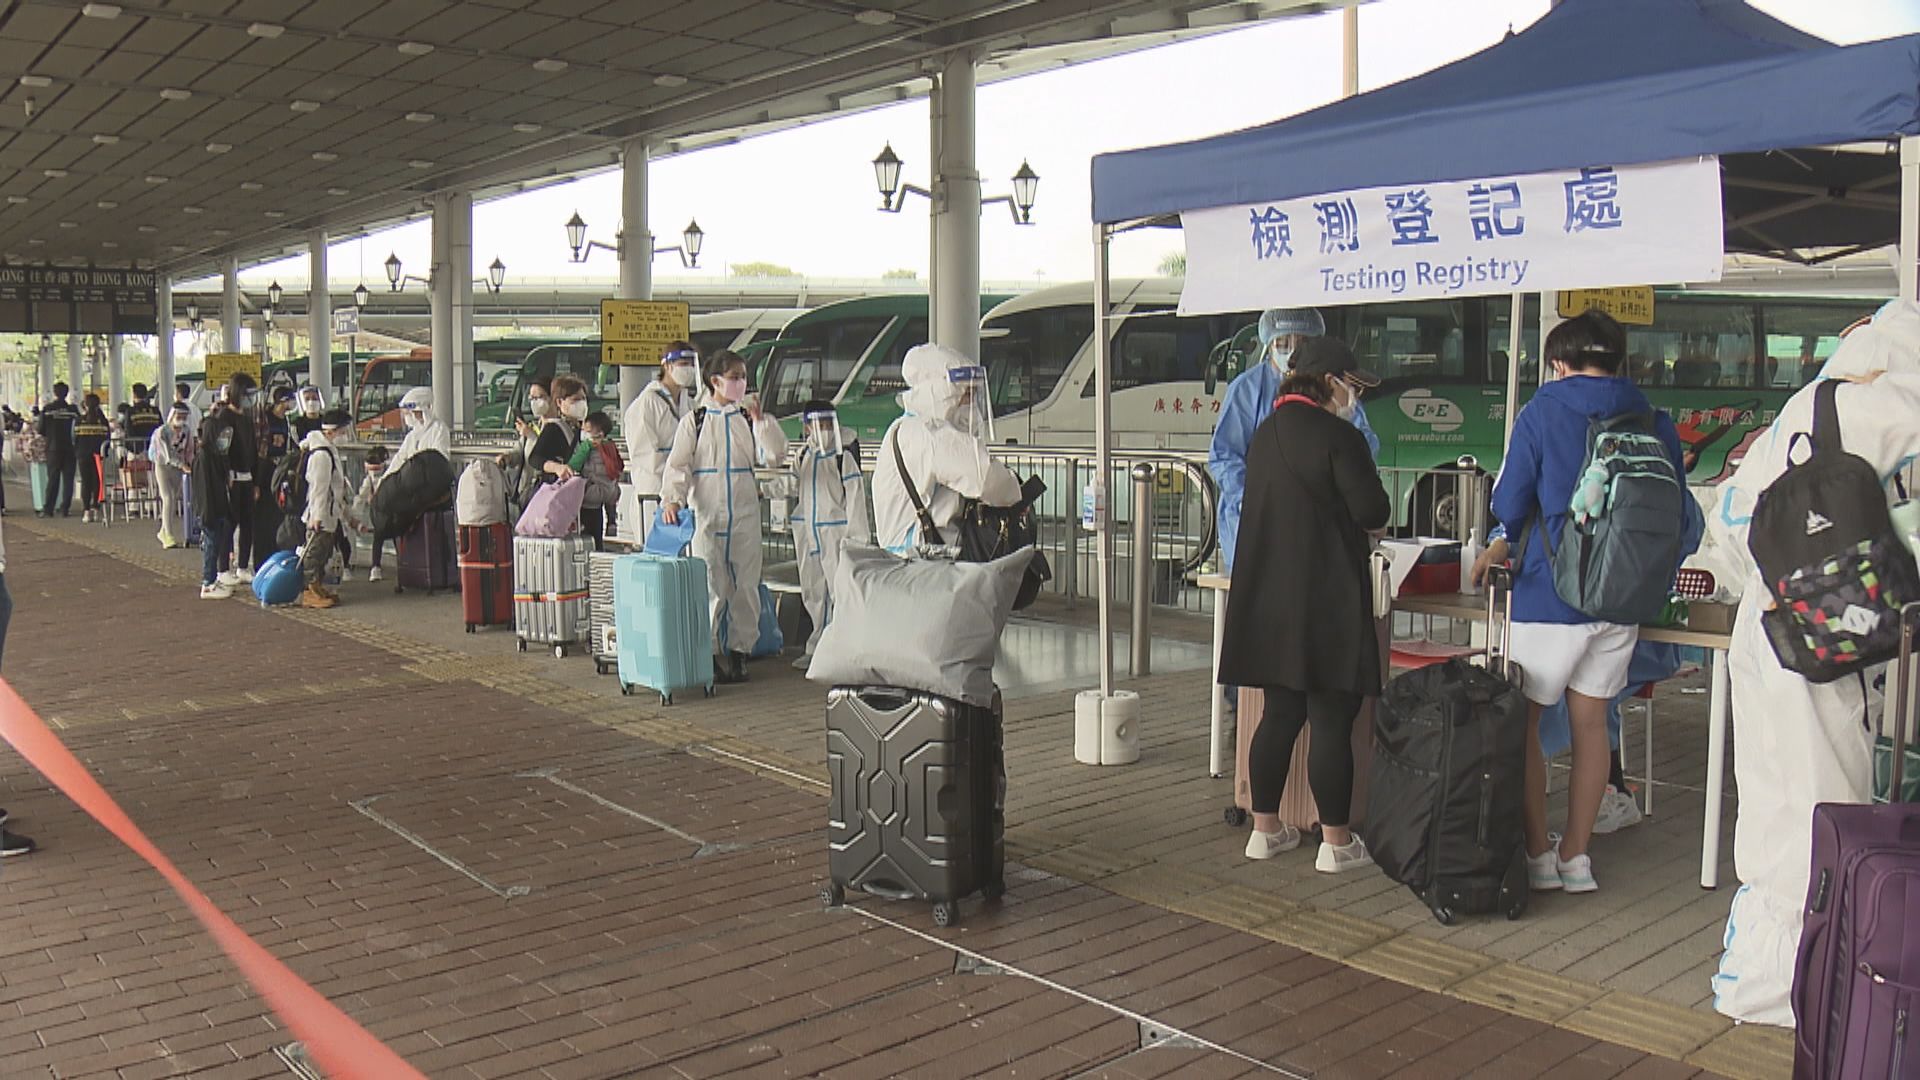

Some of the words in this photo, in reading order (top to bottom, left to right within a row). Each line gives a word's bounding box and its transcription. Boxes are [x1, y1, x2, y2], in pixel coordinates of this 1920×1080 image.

[1249, 167, 1622, 260] 檢測登記處
[0, 269, 24, 286] ONG
[73, 271, 88, 286] TO
[93, 271, 121, 286] HONG
[126, 272, 153, 287] KONG
[1320, 264, 1406, 292] Testing
[1415, 256, 1529, 290] Registry
[1664, 407, 1776, 426] 務有限公司
